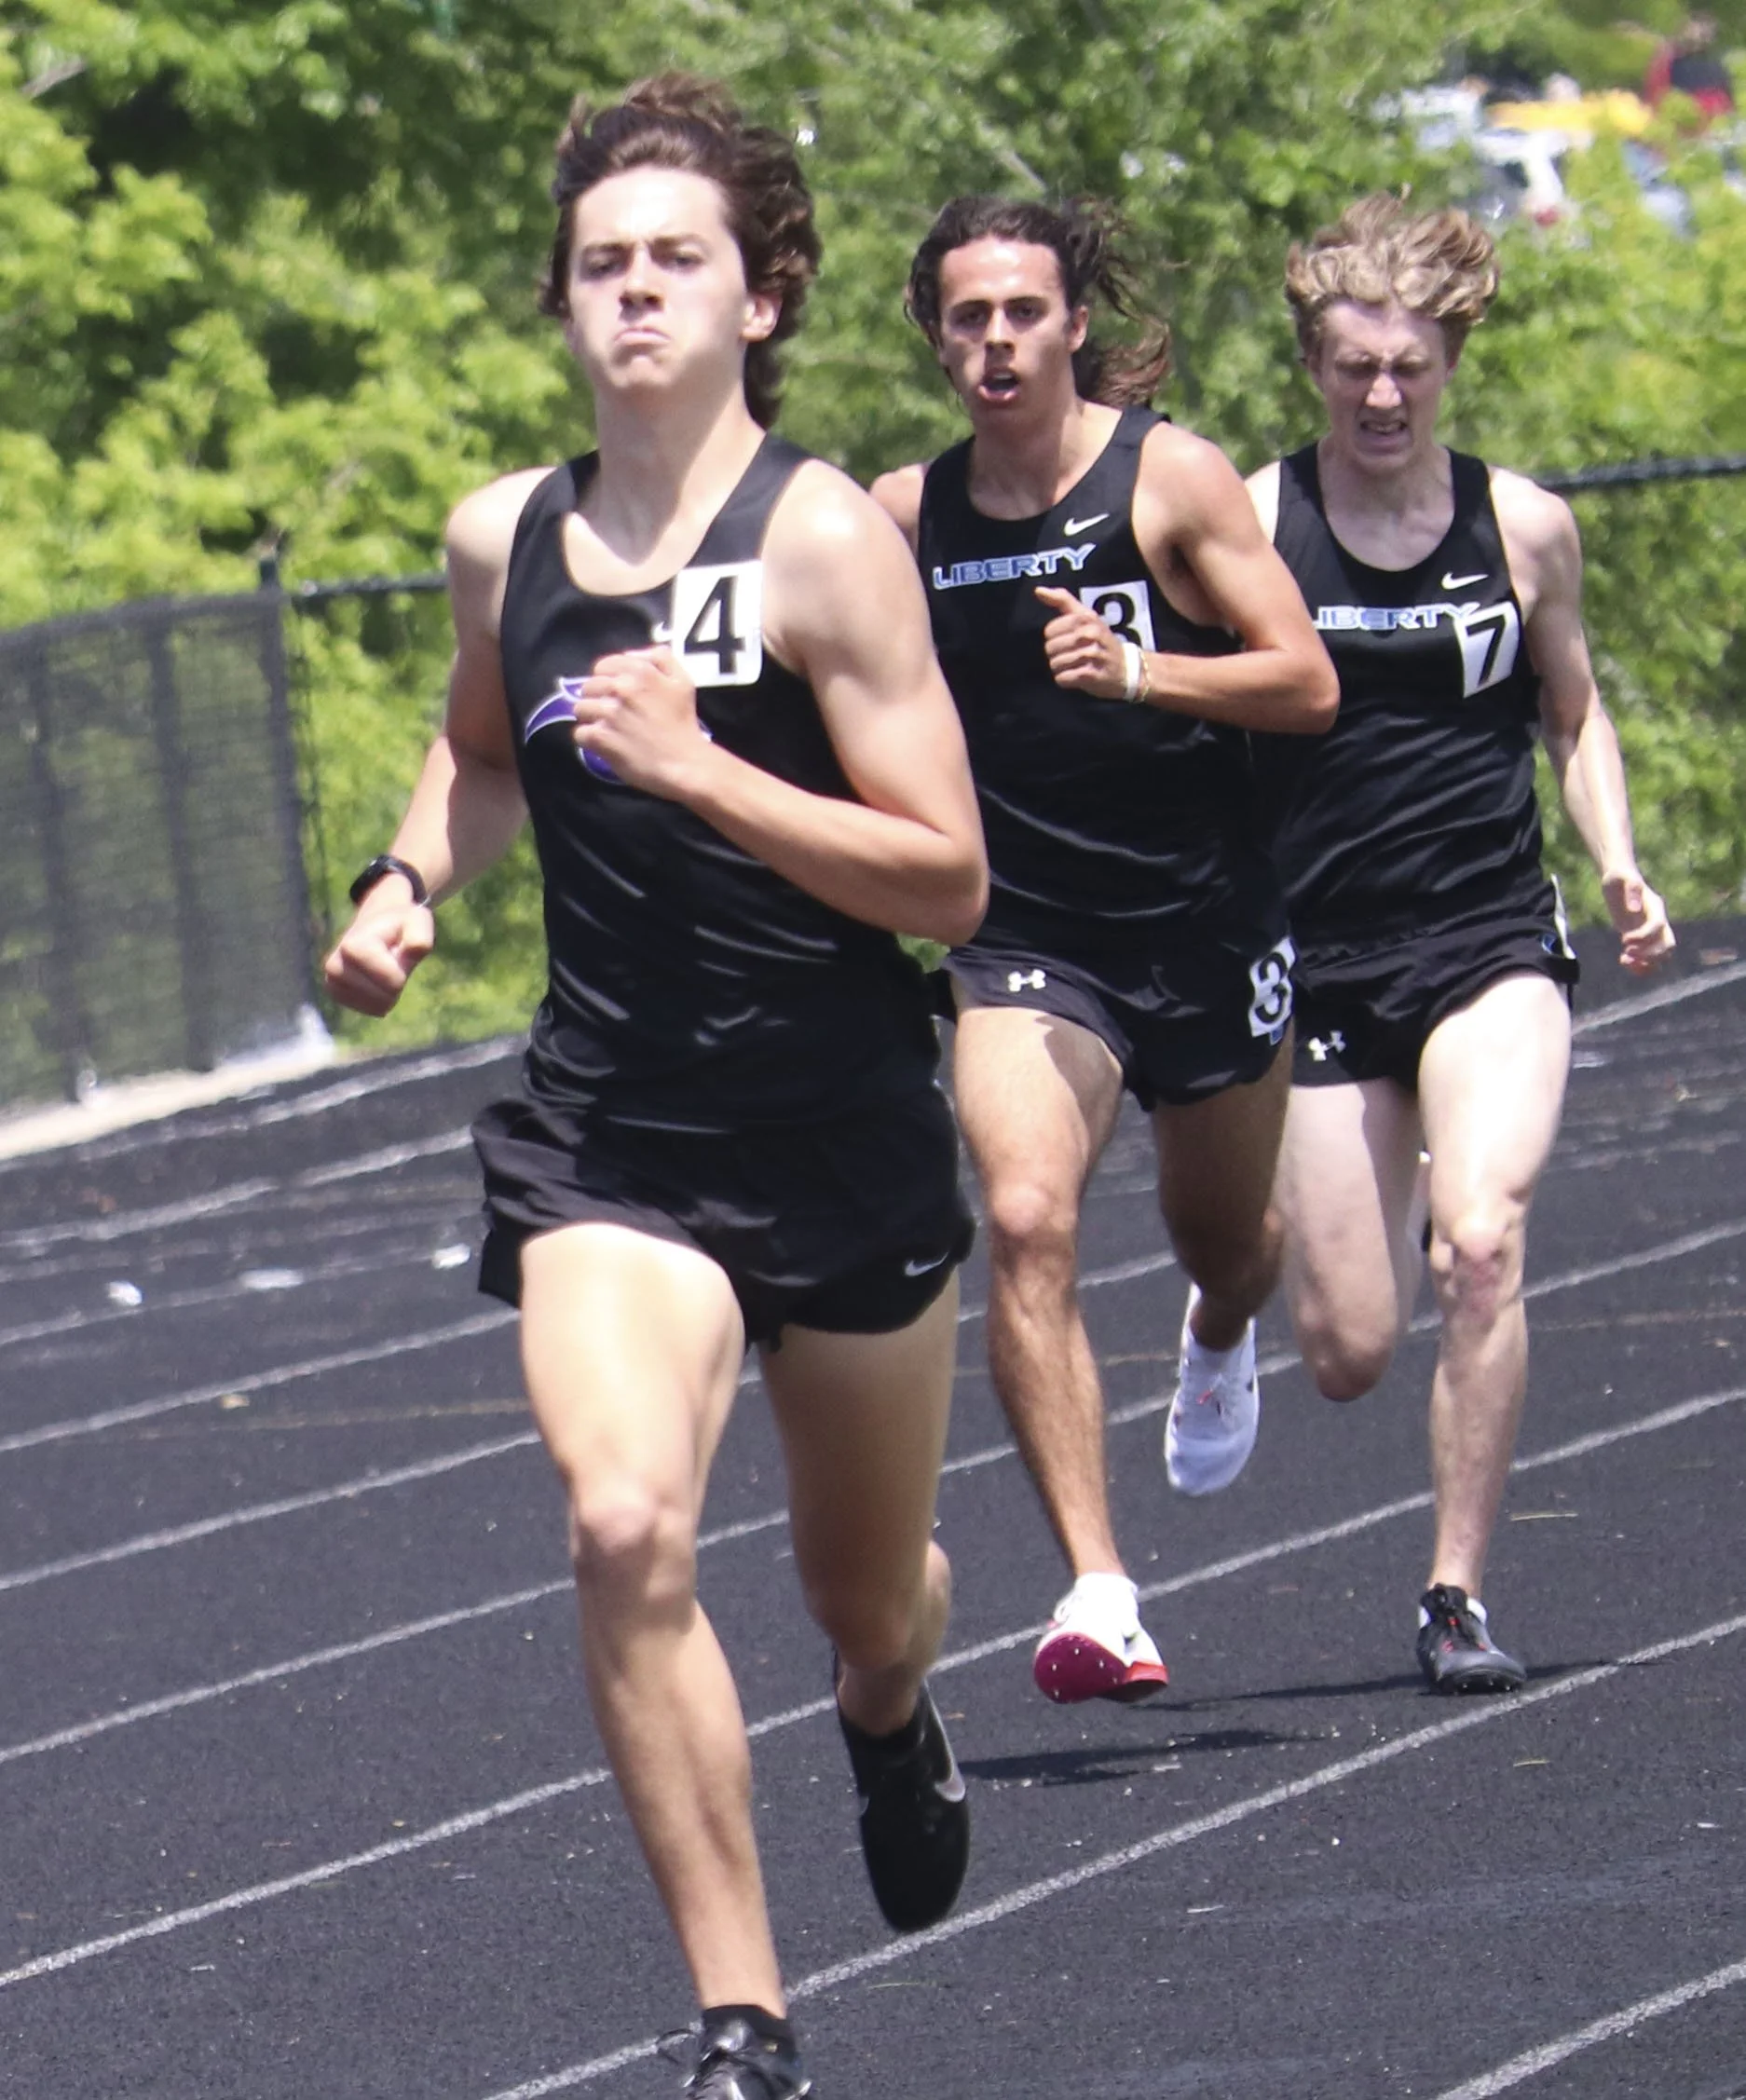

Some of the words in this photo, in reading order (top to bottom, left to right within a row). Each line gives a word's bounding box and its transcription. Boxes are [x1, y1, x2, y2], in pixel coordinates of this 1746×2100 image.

[933, 543, 1096, 590] LIBERTY
[684, 575, 745, 675] 4
[1313, 602, 1480, 630] IBERTY
[1466, 613, 1507, 689] 7
[1254, 951, 1289, 1024] 3
